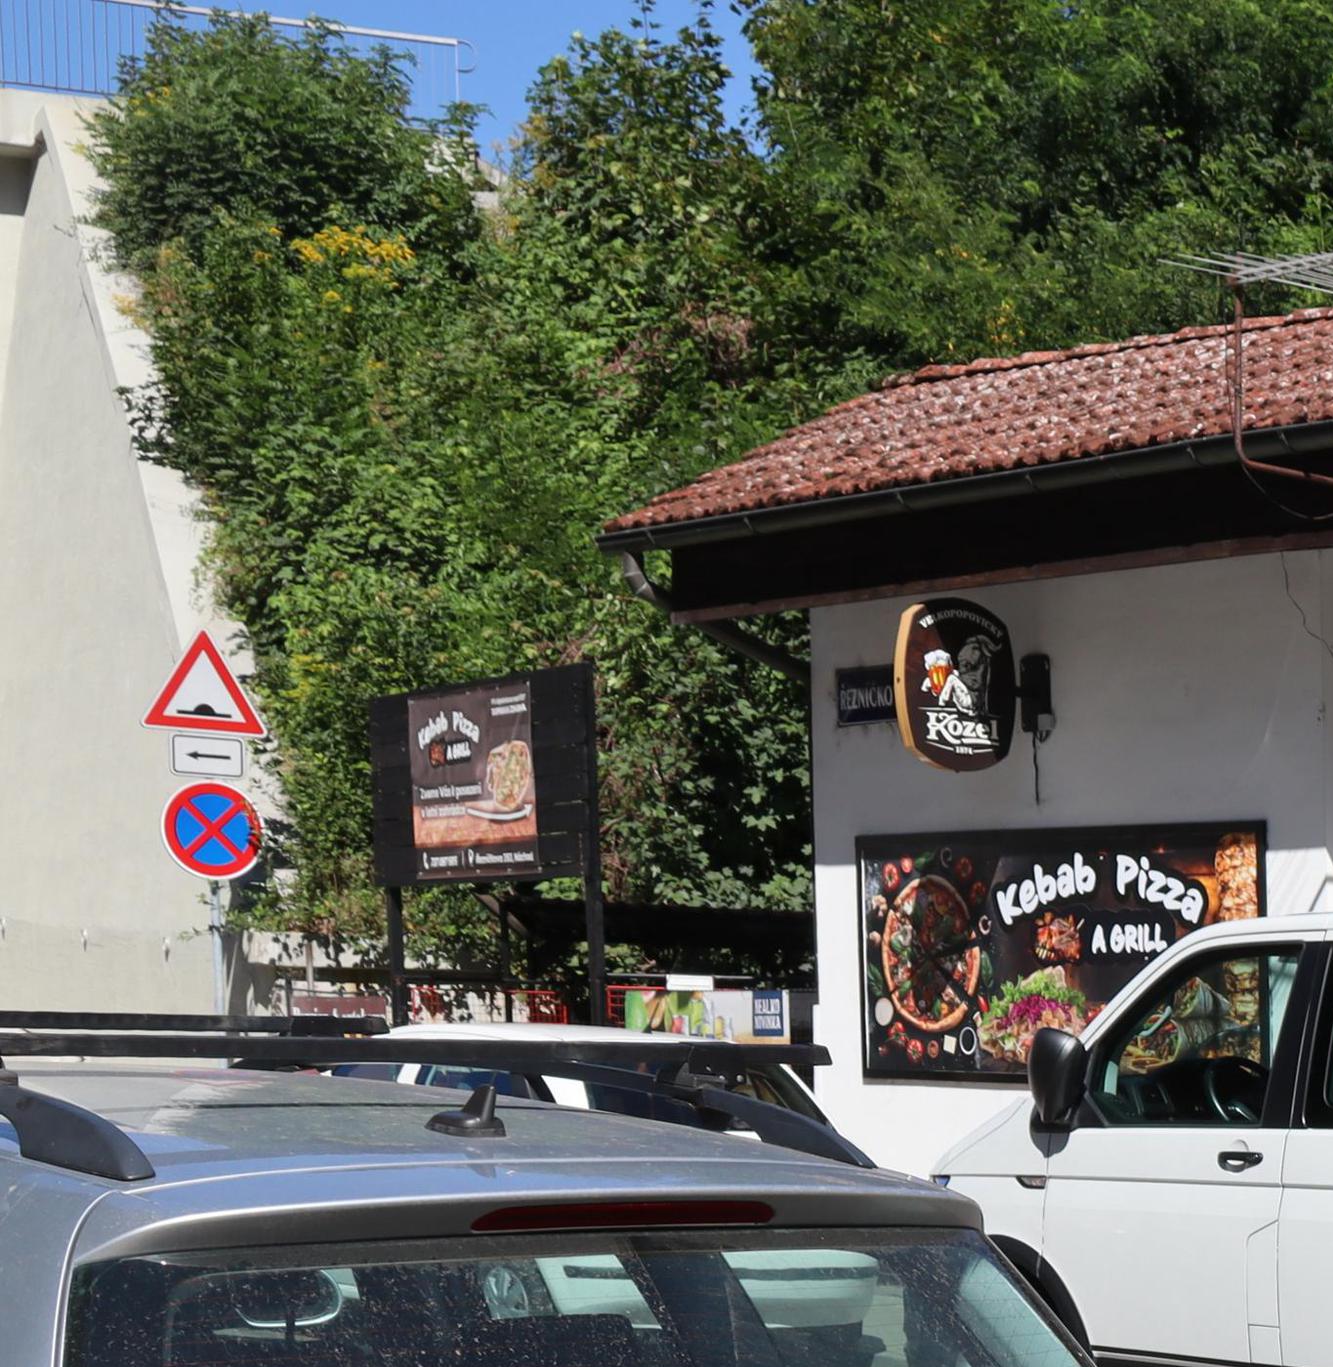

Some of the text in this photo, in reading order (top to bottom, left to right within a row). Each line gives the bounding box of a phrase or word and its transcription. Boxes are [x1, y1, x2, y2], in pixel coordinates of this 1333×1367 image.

[926, 711, 999, 744] Kozel
[996, 852, 1203, 925] Kebab Pizza
[1092, 923, 1168, 955] A GRILL
